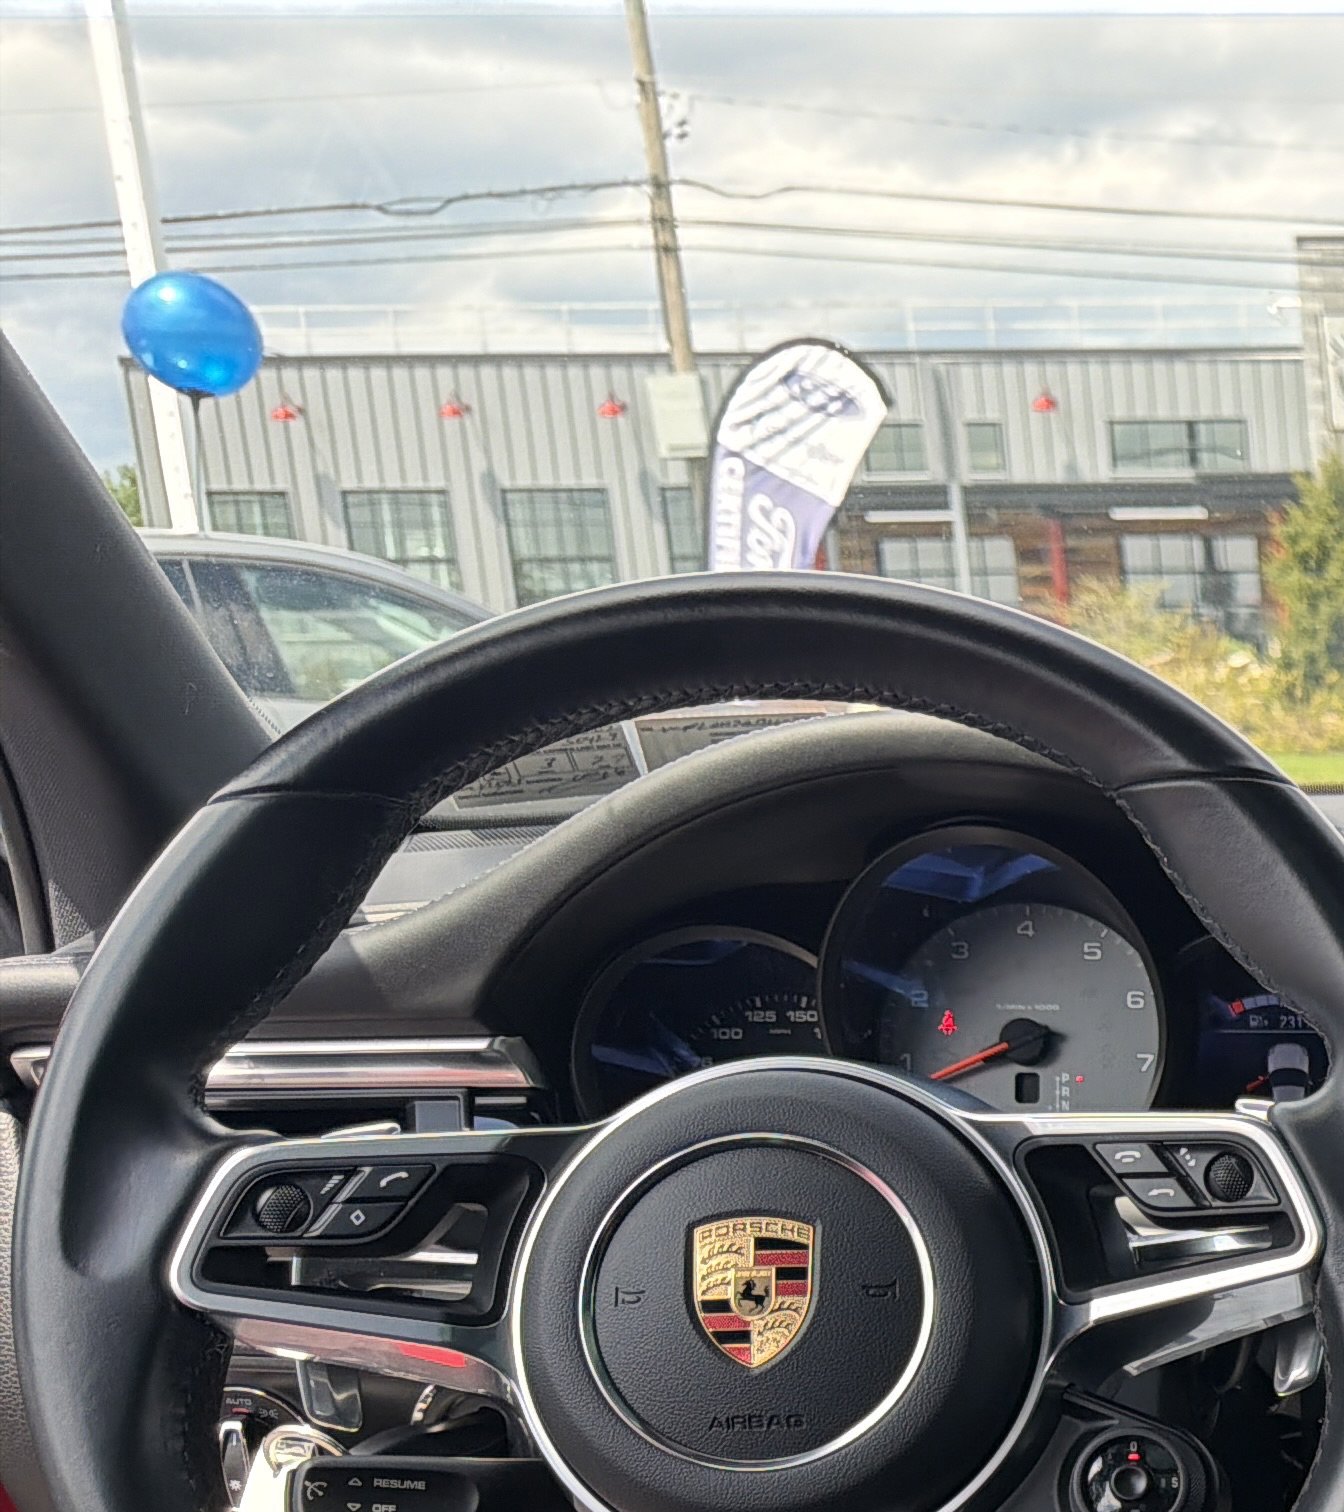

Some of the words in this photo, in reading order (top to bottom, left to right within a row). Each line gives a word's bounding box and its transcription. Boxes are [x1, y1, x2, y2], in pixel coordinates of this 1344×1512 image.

[1017, 920, 1035, 938] 4
[951, 941, 970, 960] 3
[1083, 942, 1102, 961] 5
[910, 990, 929, 1008] 2
[1126, 991, 1145, 1010] 6
[745, 1010, 777, 1022] 125
[786, 1010, 819, 1022] 150
[1279, 1015, 1302, 1028] 231
[711, 1028, 743, 1040] 100
[900, 1053, 912, 1071] 1
[1136, 1053, 1155, 1072] 7
[1061, 1073, 1070, 1083] P
[700, 1221, 811, 1242] PORSCHE
[225, 1397, 252, 1406] AUTO
[708, 1413, 806, 1431] AIRBAG
[373, 1478, 426, 1490] RESUME
[1171, 1477, 1179, 1488] S
